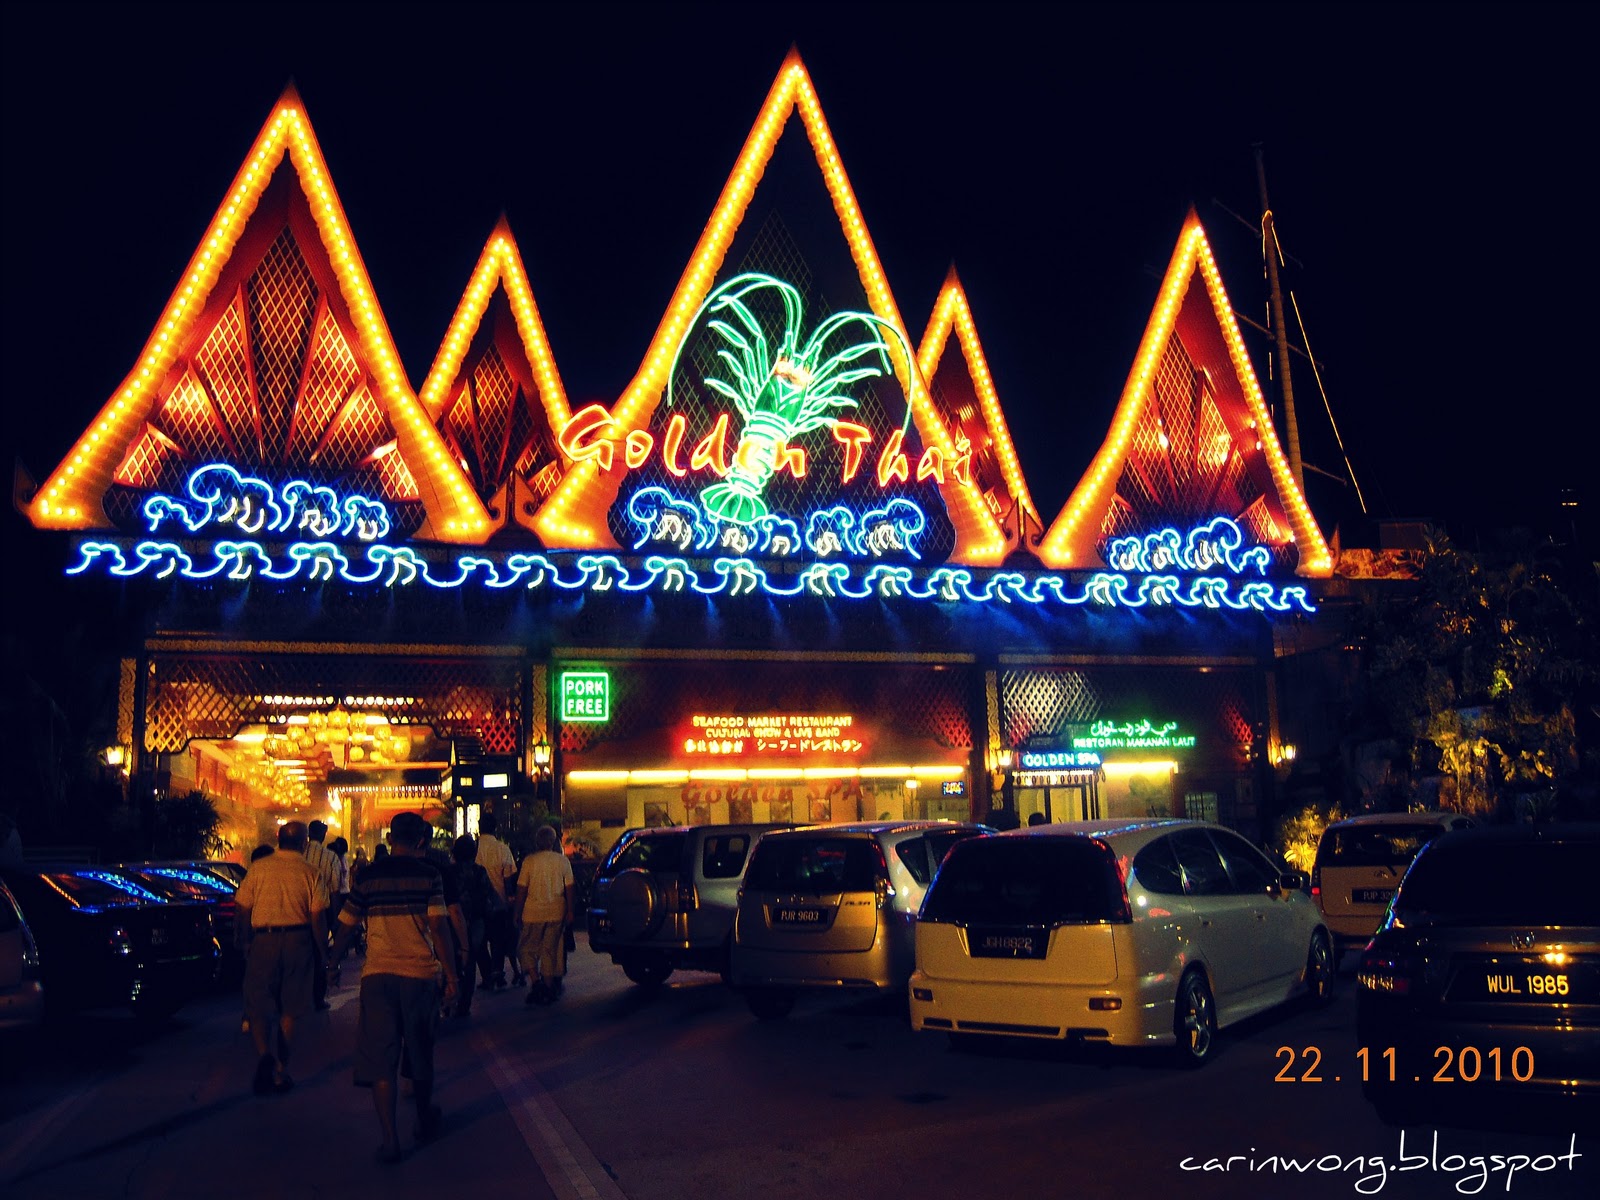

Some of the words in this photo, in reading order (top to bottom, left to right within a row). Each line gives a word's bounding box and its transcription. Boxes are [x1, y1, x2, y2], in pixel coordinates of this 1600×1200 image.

[831, 420, 972, 487] Thai
[566, 680, 604, 695] PORK
[567, 698, 603, 714] FREE
[692, 716, 744, 727] SEAFOOD
[748, 716, 786, 727] MARKET
[790, 716, 852, 727] RESTAURANT
[705, 728, 750, 738] CULTURAL
[753, 728, 781, 738] SHOW
[784, 728, 791, 738] &
[793, 728, 812, 738] LIVE
[815, 728, 840, 738] BAND
[1073, 738, 1124, 748] RESTORAN
[1126, 737, 1170, 748] MAKANAN
[1172, 736, 1196, 747] LAUT
[1023, 752, 1076, 767] GOLDEN
[1077, 752, 1101, 766] SPA
[781, 910, 796, 921] PJR
[798, 910, 819, 921] 9603
[1487, 975, 1521, 993] WUL
[1527, 975, 1569, 995] 1985
